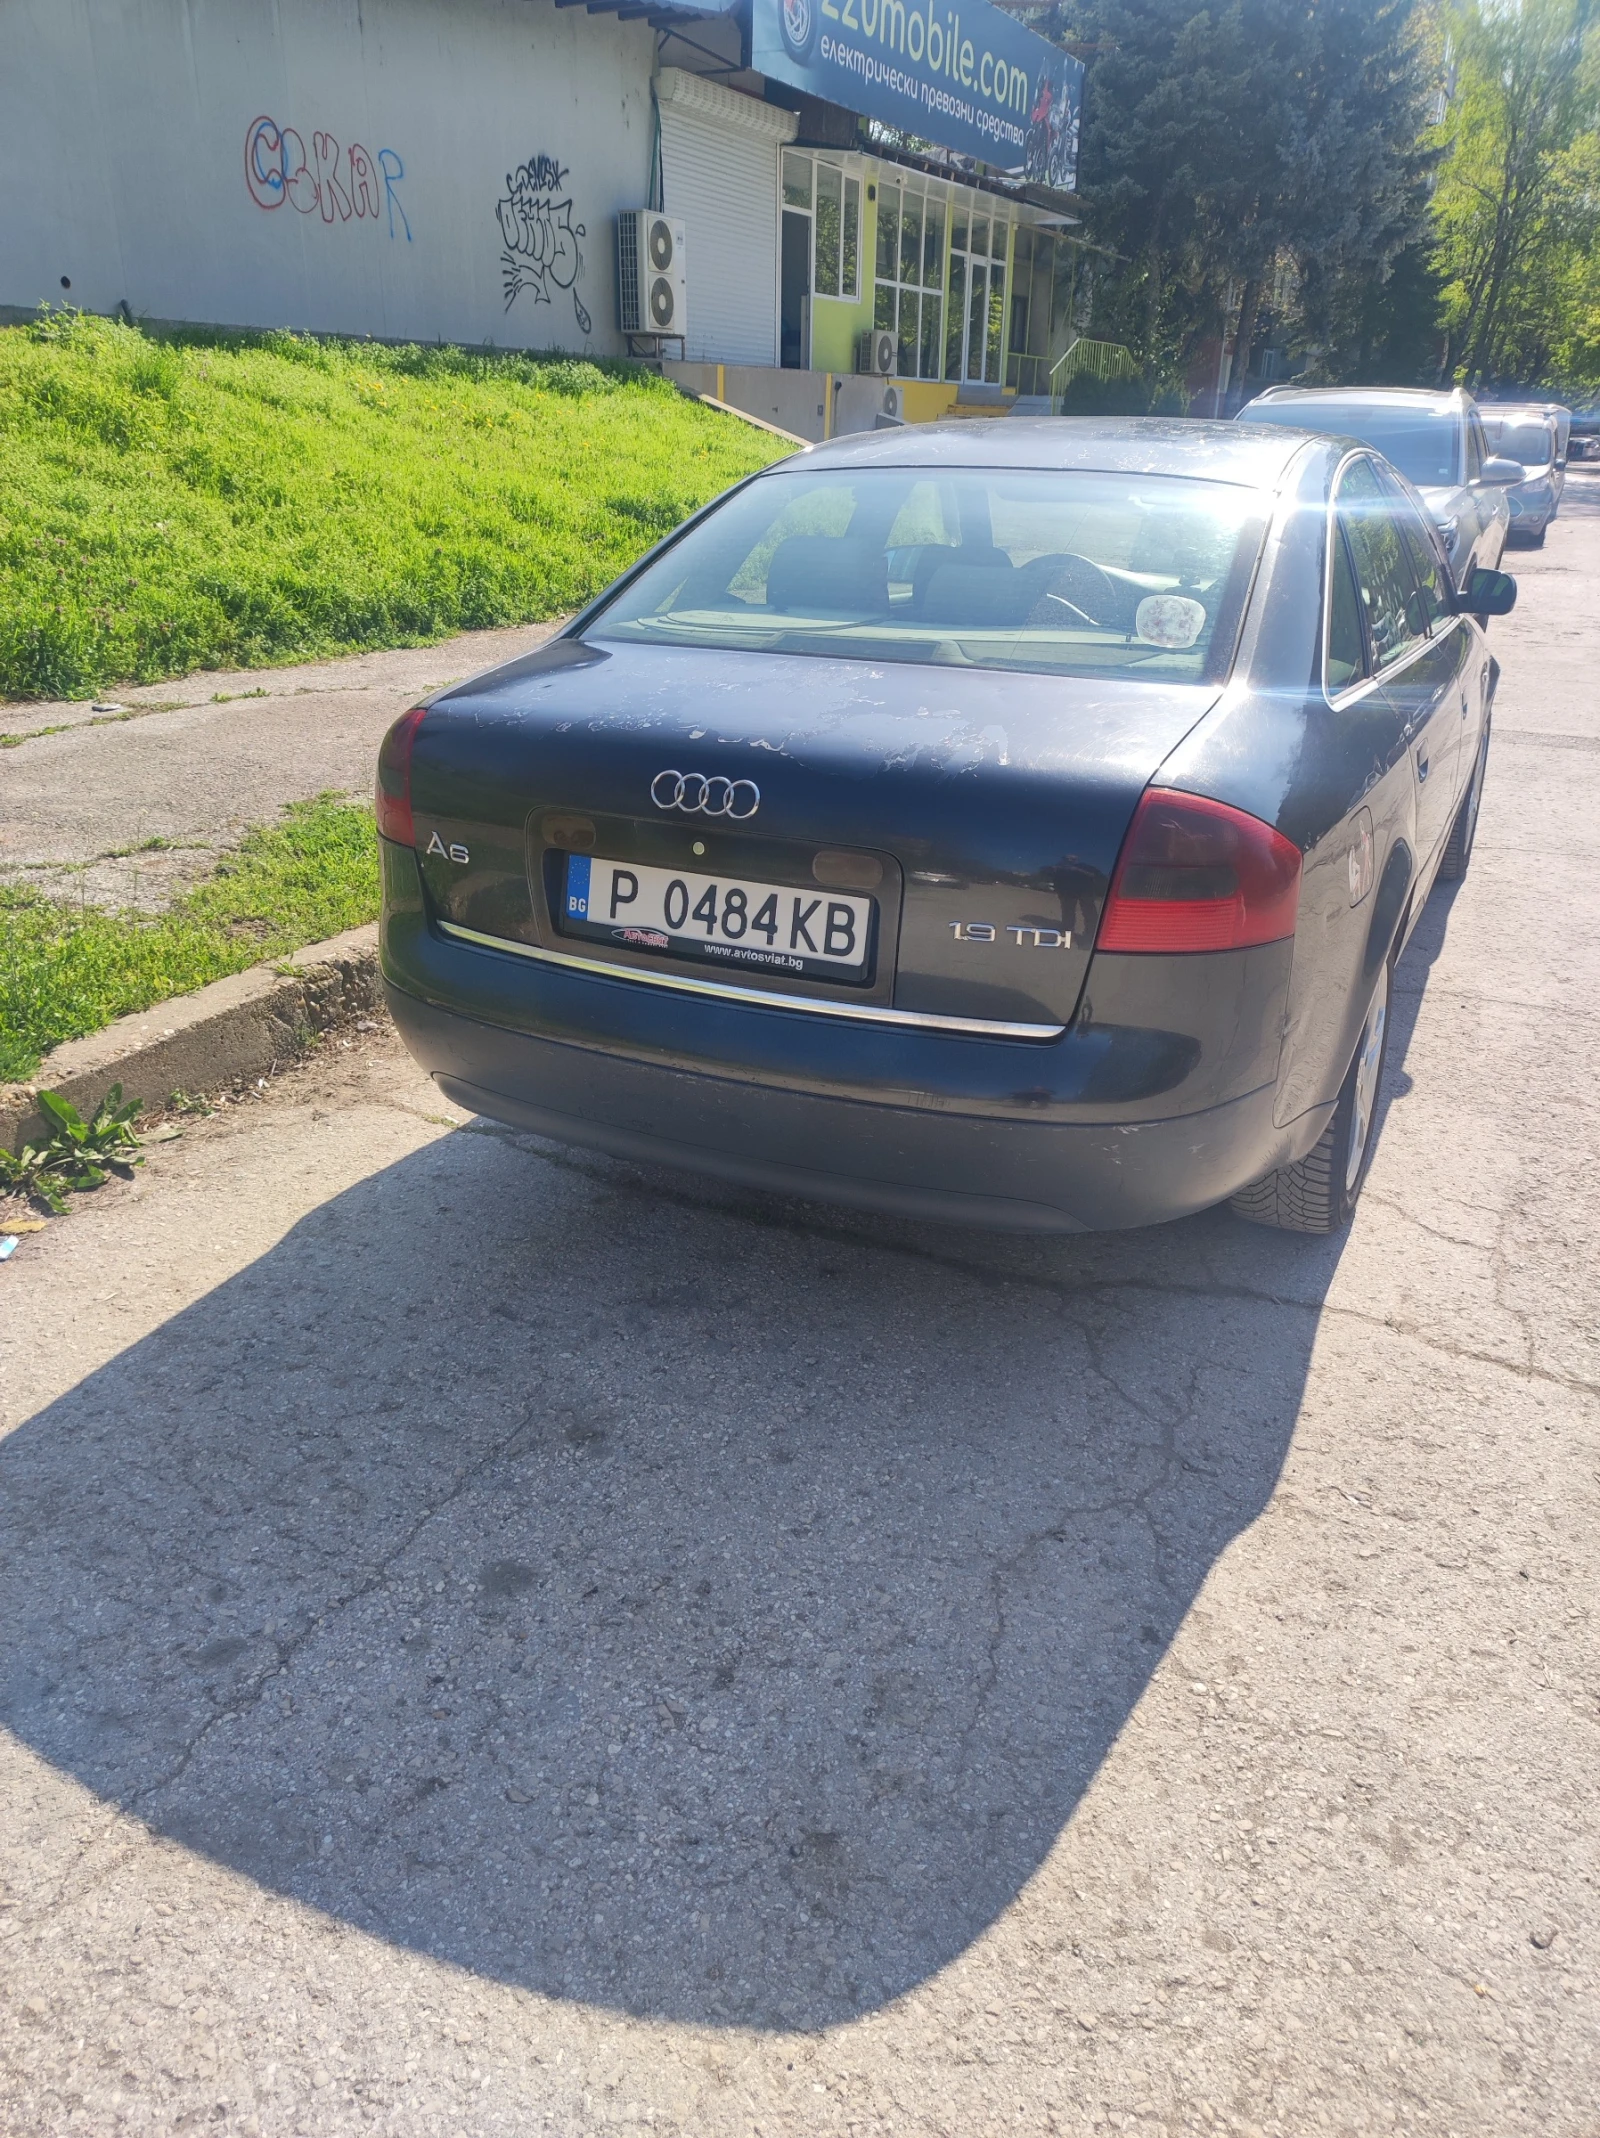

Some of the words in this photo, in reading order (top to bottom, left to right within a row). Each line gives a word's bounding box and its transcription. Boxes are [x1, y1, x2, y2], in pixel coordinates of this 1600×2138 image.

[821, 0, 1027, 115] 0mobile.com
[820, 35, 918, 100] електрически
[921, 82, 975, 125] превозни
[425, 830, 470, 864] A6
[568, 895, 587, 913] BG
[663, 878, 856, 957] 0484KB
[1006, 924, 1072, 950] TDI
[703, 943, 804, 971] www.avtosviat.bg
